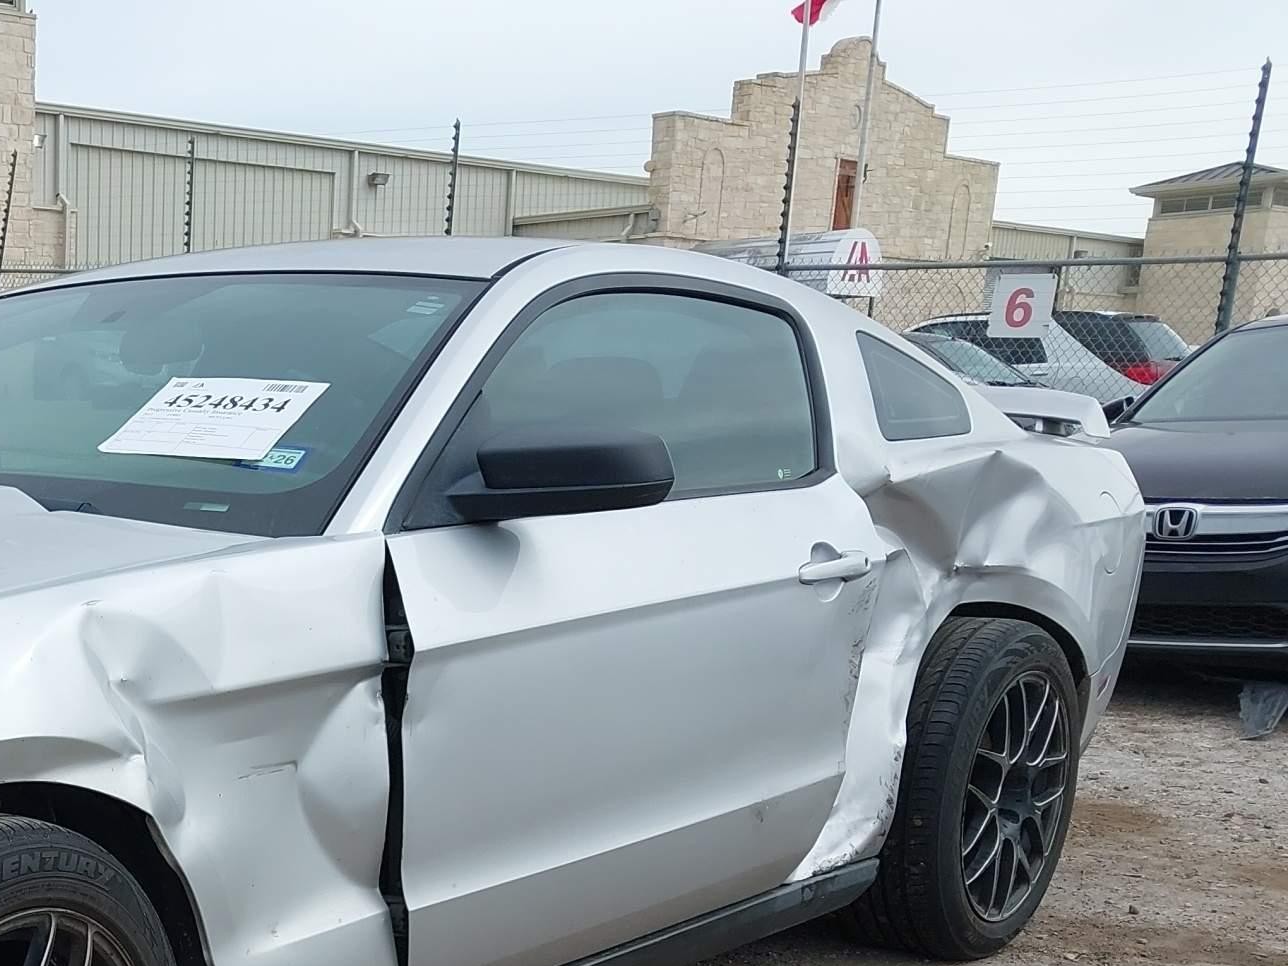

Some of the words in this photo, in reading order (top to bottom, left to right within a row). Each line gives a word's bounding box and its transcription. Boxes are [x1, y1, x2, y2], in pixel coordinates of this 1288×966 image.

[1004, 287, 1035, 328] 6
[164, 393, 292, 413] 45248434
[273, 454, 297, 465] 26
